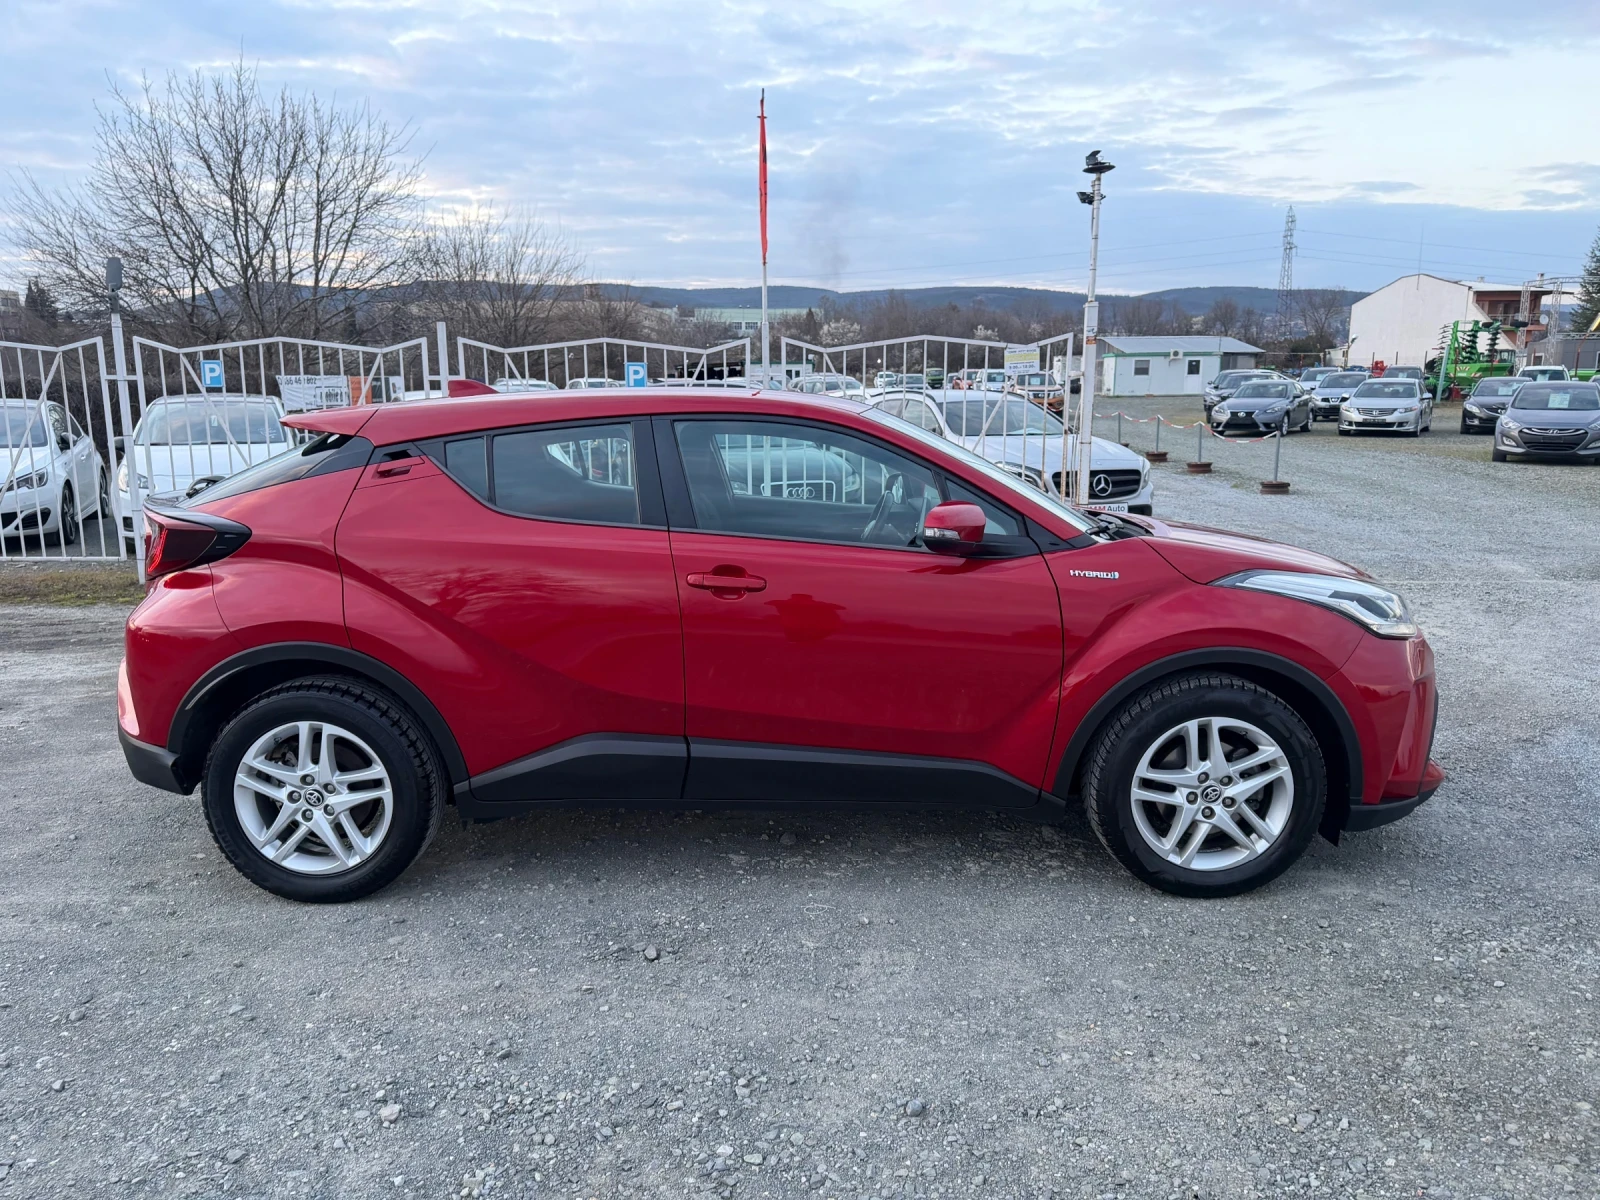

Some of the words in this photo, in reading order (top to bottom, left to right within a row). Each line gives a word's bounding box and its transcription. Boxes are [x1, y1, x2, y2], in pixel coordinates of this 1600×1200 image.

[204, 364, 220, 385] P
[629, 366, 644, 387] P
[1069, 570, 1112, 579] HYBRID
